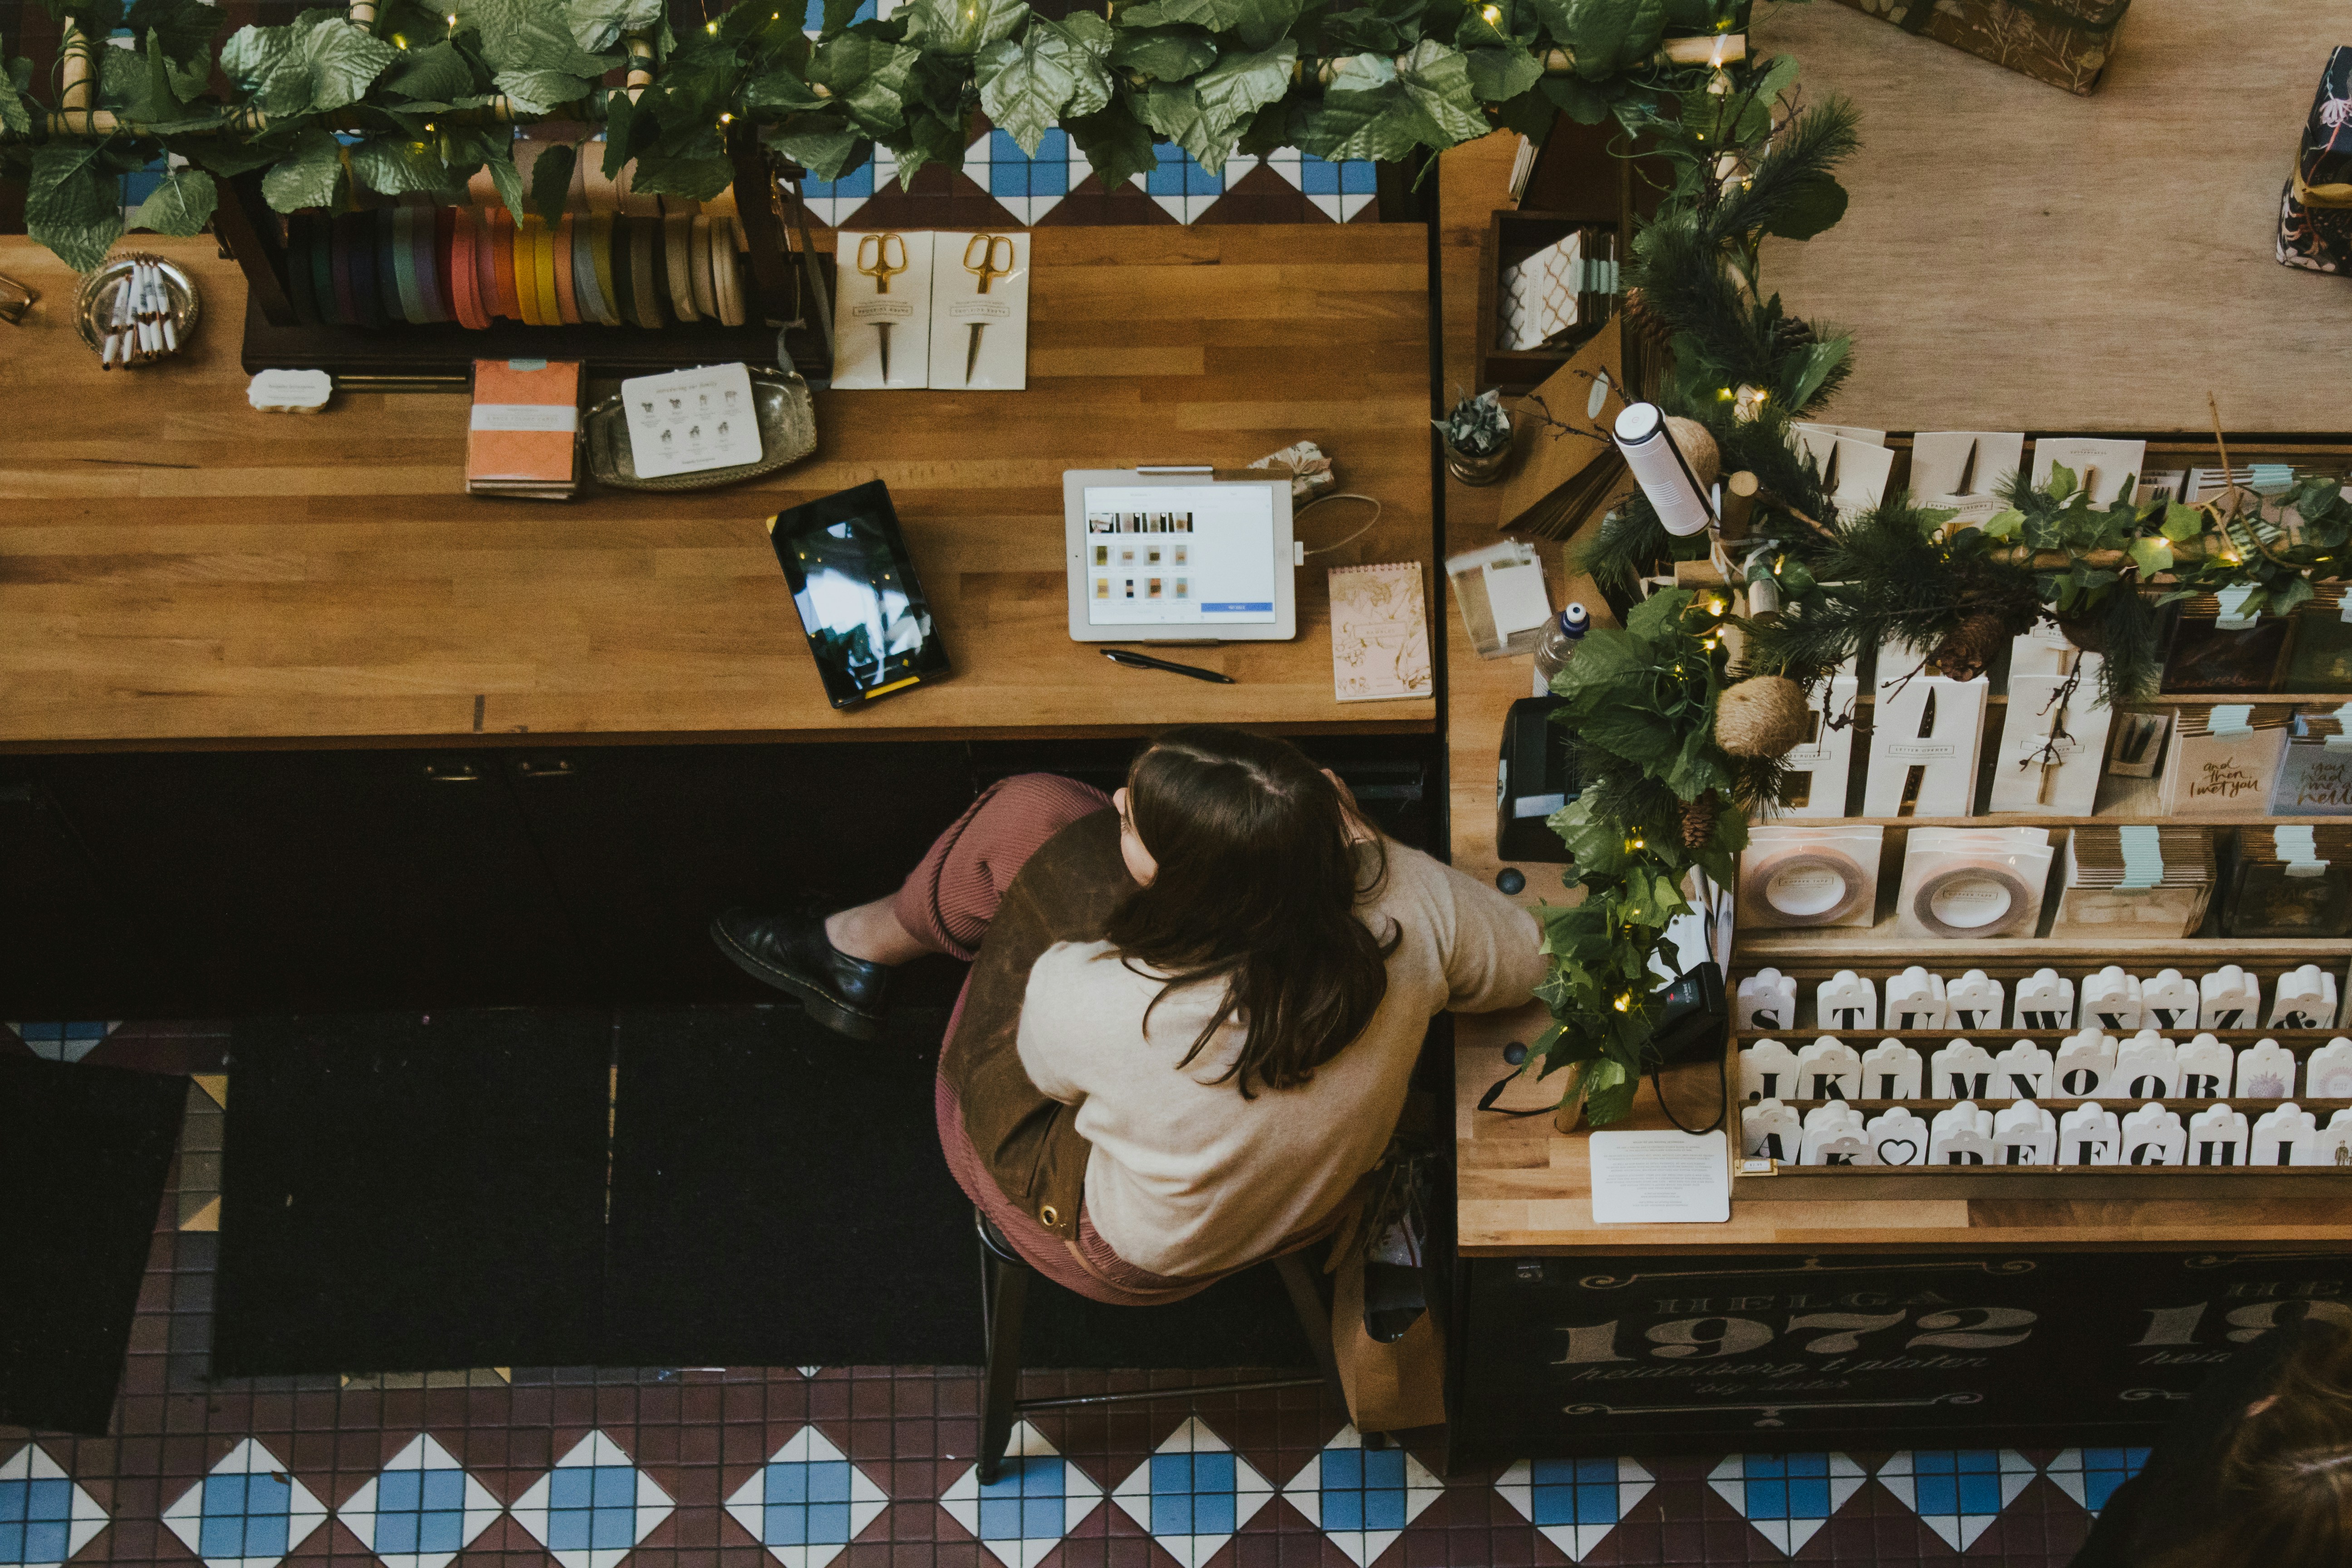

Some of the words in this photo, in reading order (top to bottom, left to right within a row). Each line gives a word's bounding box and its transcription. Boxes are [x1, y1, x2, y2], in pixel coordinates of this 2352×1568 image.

[2203, 757, 2240, 771] and
[2190, 782, 2195, 798] I
[2197, 780, 2231, 796] met
[2229, 779, 2262, 798] you
[1751, 1009, 1780, 1029] S
[1833, 1008, 1864, 1029] T
[1955, 1010, 1992, 1029] V
[2021, 1011, 2070, 1029] W
[2151, 1009, 2188, 1029] Y
[2214, 1009, 2244, 1029] Z
[1813, 1074, 1847, 1099] K
[1950, 1073, 1991, 1099] M
[2009, 1073, 2043, 1098] N
[2062, 1069, 2098, 1095] O
[1751, 1132, 1785, 1161] A
[2005, 1145, 2036, 1165] E
[2131, 1142, 2166, 1165] G
[2198, 1141, 2238, 1165] H
[1654, 1289, 1955, 1315] HELGA
[1550, 1306, 2038, 1366] 1972
